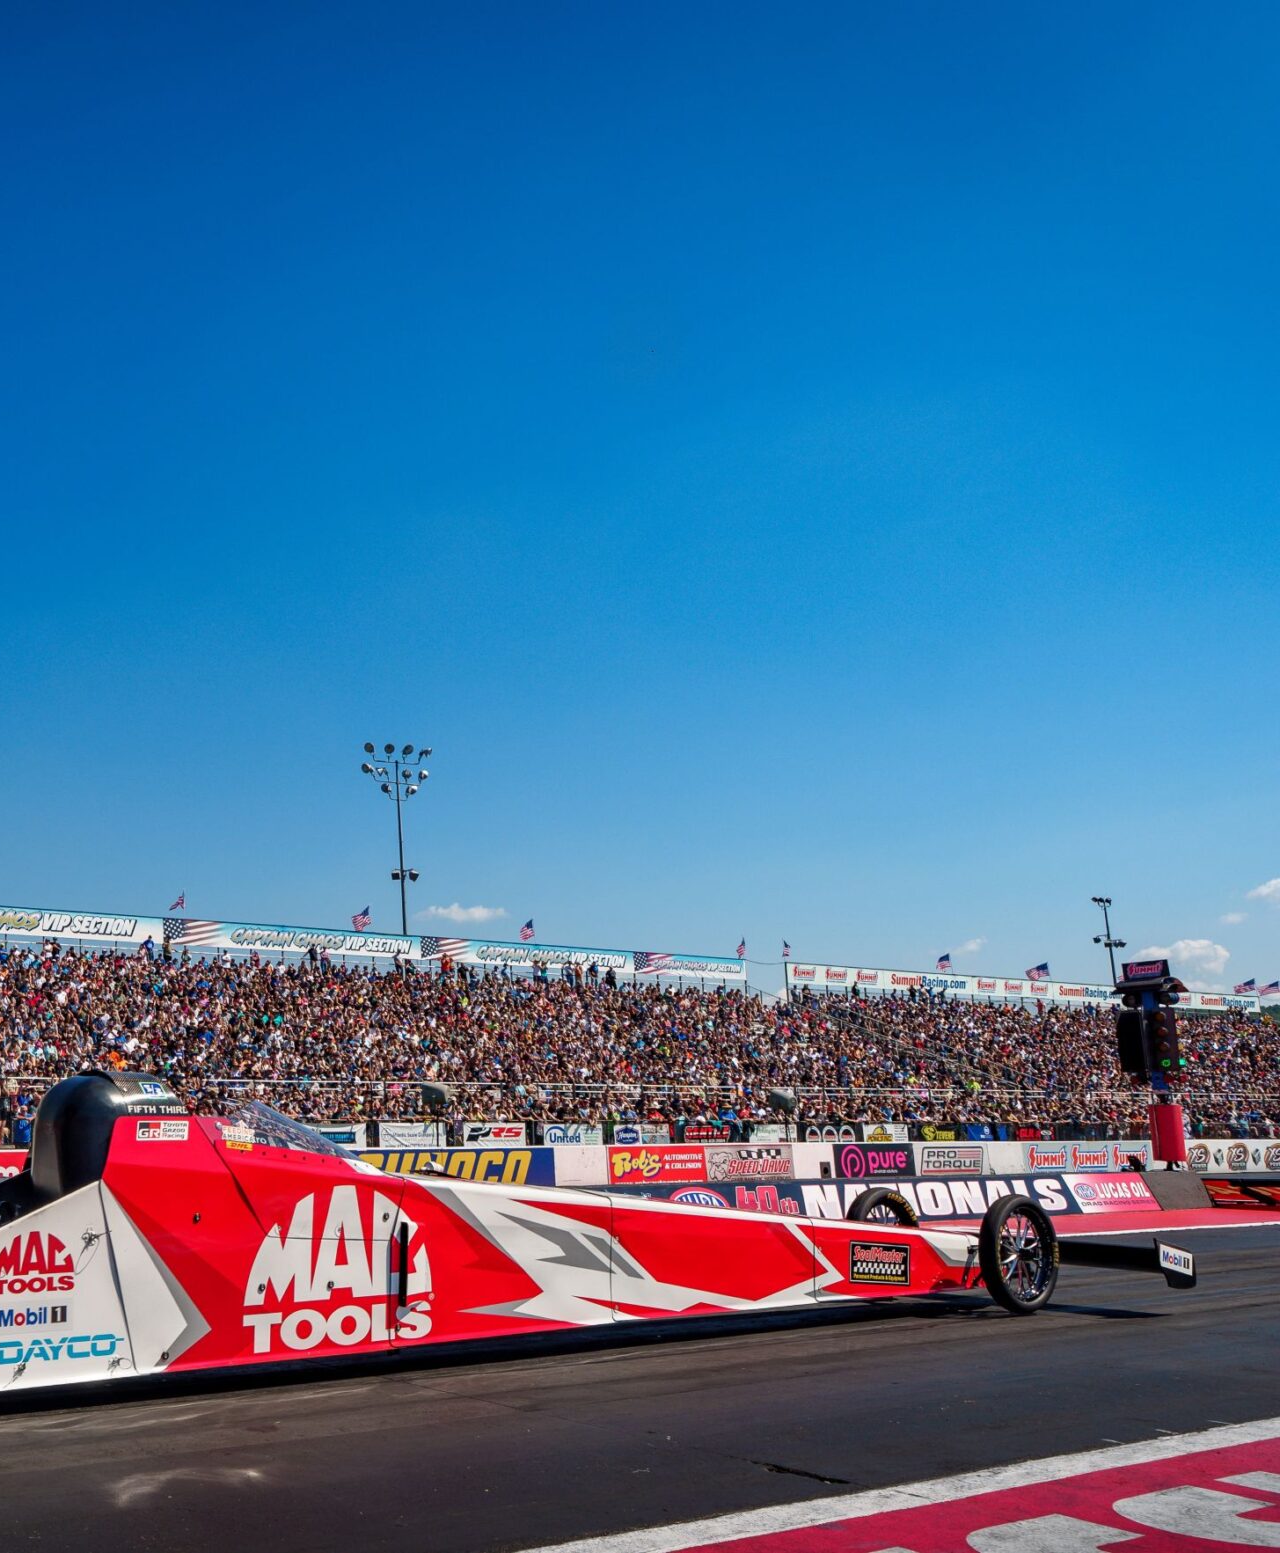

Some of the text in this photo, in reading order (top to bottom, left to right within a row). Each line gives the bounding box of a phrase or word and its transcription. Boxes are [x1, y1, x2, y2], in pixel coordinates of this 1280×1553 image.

[43, 912, 71, 933] VIP
[70, 914, 137, 937] SECTION
[230, 927, 411, 954] CAPTAIN CHAOS VIP SECTION
[476, 945, 626, 968] CAPTAIN CHAOS VIP SECTION
[1127, 961, 1163, 976] SUMMIT
[891, 974, 966, 989] SummitRacing.com
[128, 1105, 189, 1114] FIFTH THIRD
[138, 1128, 161, 1138] GR
[549, 1133, 581, 1144] United
[867, 1151, 907, 1173] pure
[927, 1150, 957, 1159] PRO
[1028, 1145, 1066, 1172] SUMMIT
[1071, 1145, 1108, 1172] SUMMIT
[1113, 1145, 1147, 1170] SUIT
[1189, 1148, 1206, 1163] XS
[1228, 1147, 1244, 1161] XS
[728, 1158, 791, 1176] SPEED DAWG
[924, 1160, 980, 1169] TORQUE
[801, 1178, 1068, 1220] NAIONAS
[1095, 1182, 1150, 1199] LUCAS OIL
[244, 1185, 432, 1306] MAC
[853, 1246, 904, 1263] SealMaster
[1162, 1250, 1182, 1267] Mobil
[243, 1301, 432, 1354] TOOLS
